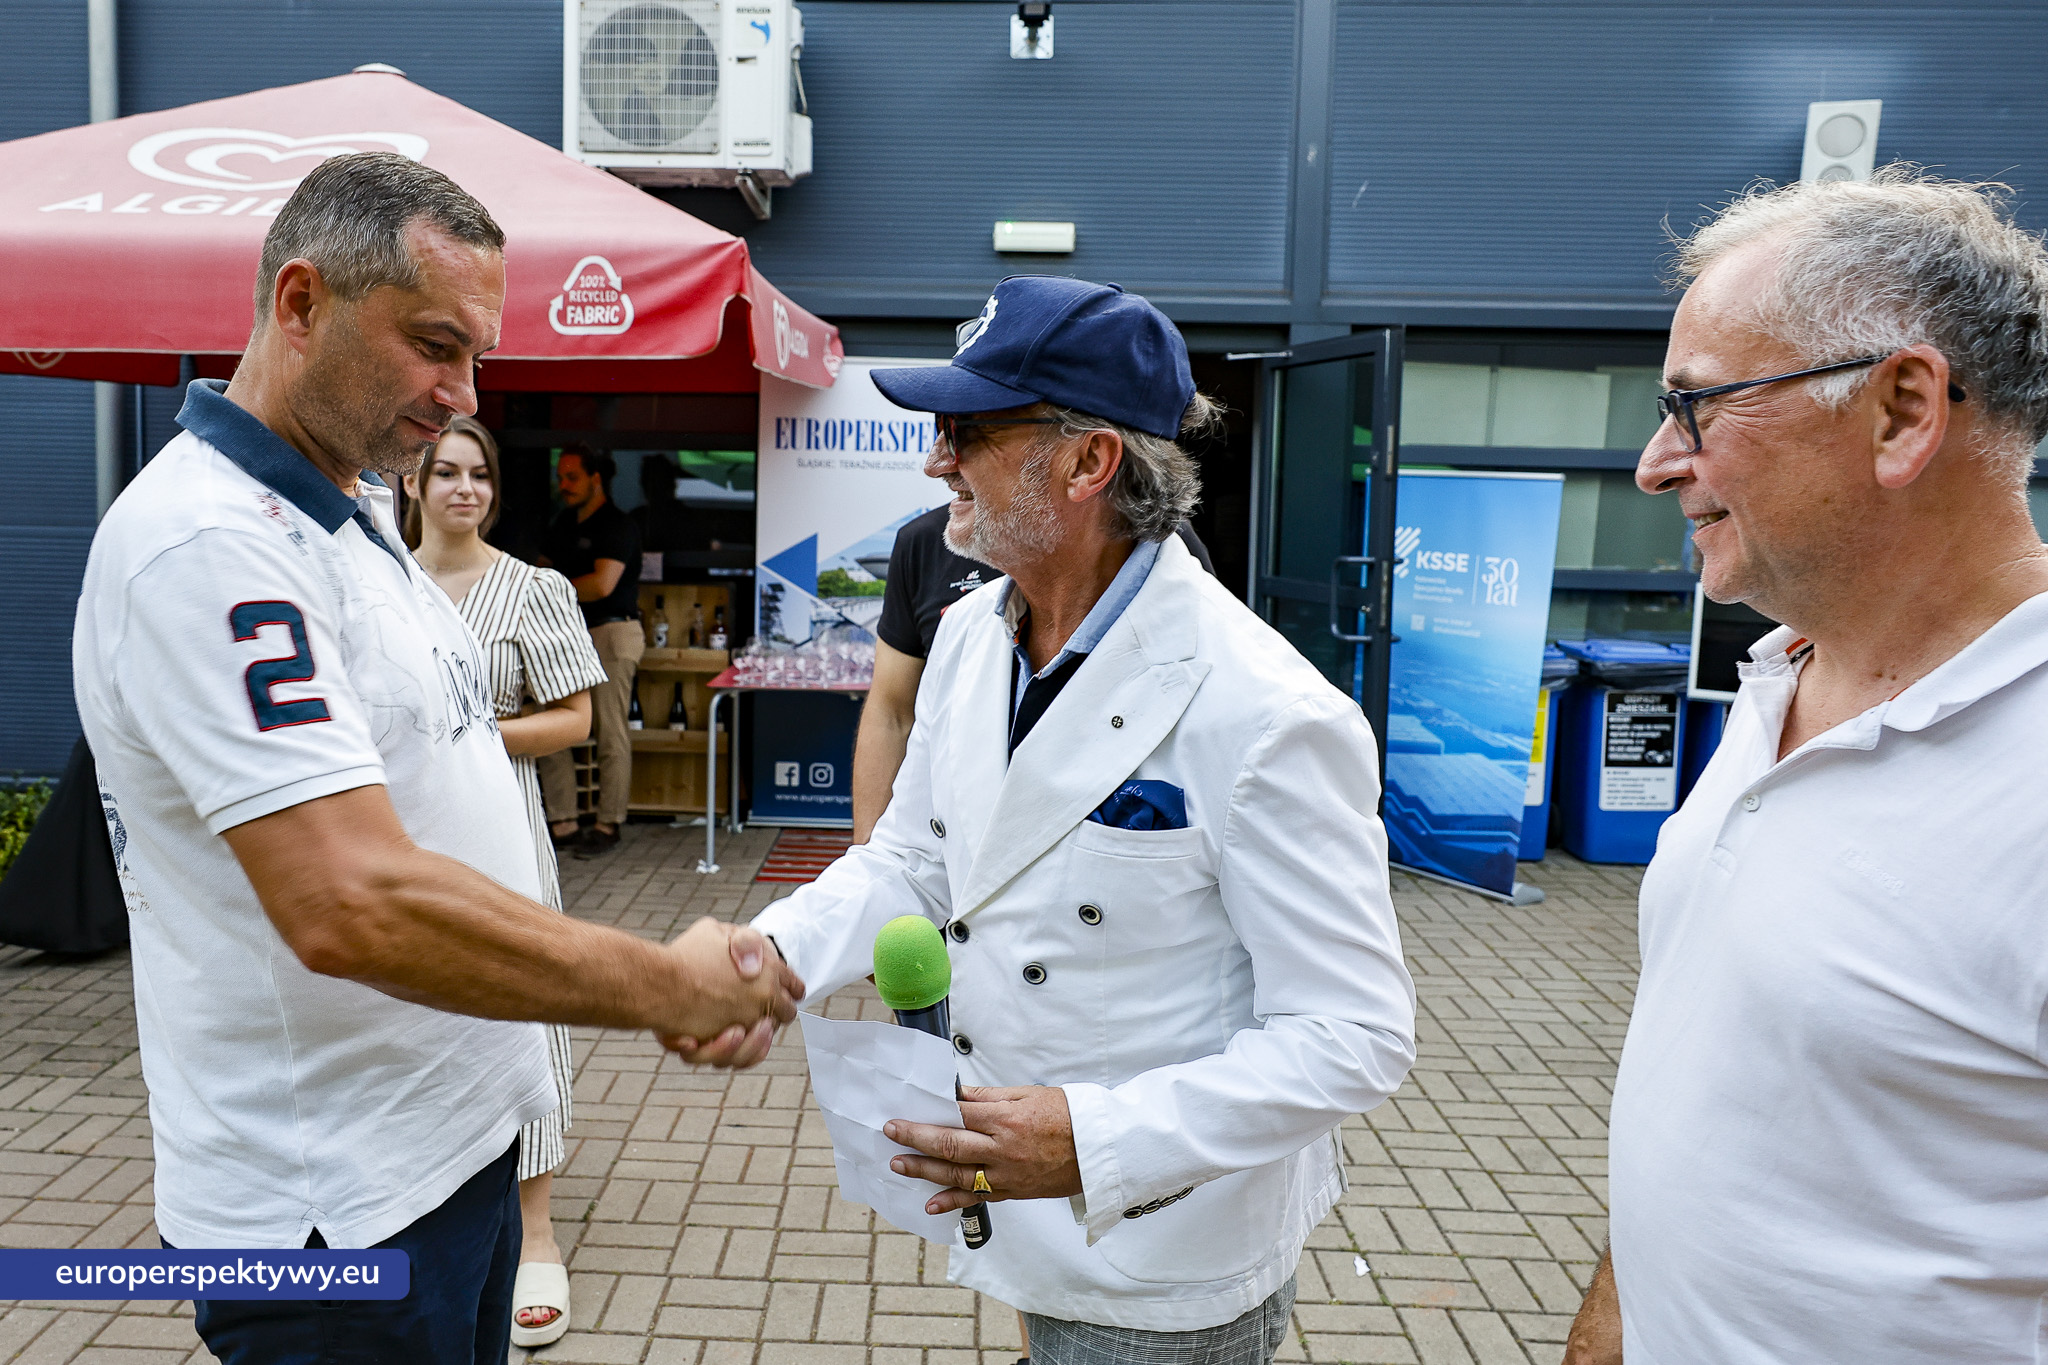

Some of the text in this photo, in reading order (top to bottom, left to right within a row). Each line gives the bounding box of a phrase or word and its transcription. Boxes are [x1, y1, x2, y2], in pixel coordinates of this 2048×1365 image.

[579, 275, 605, 288] 100%
[569, 290, 618, 303] RECYCLED
[1416, 550, 1470, 573] KSSE
[1482, 557, 1519, 586] 30
[227, 599, 333, 732] 2
